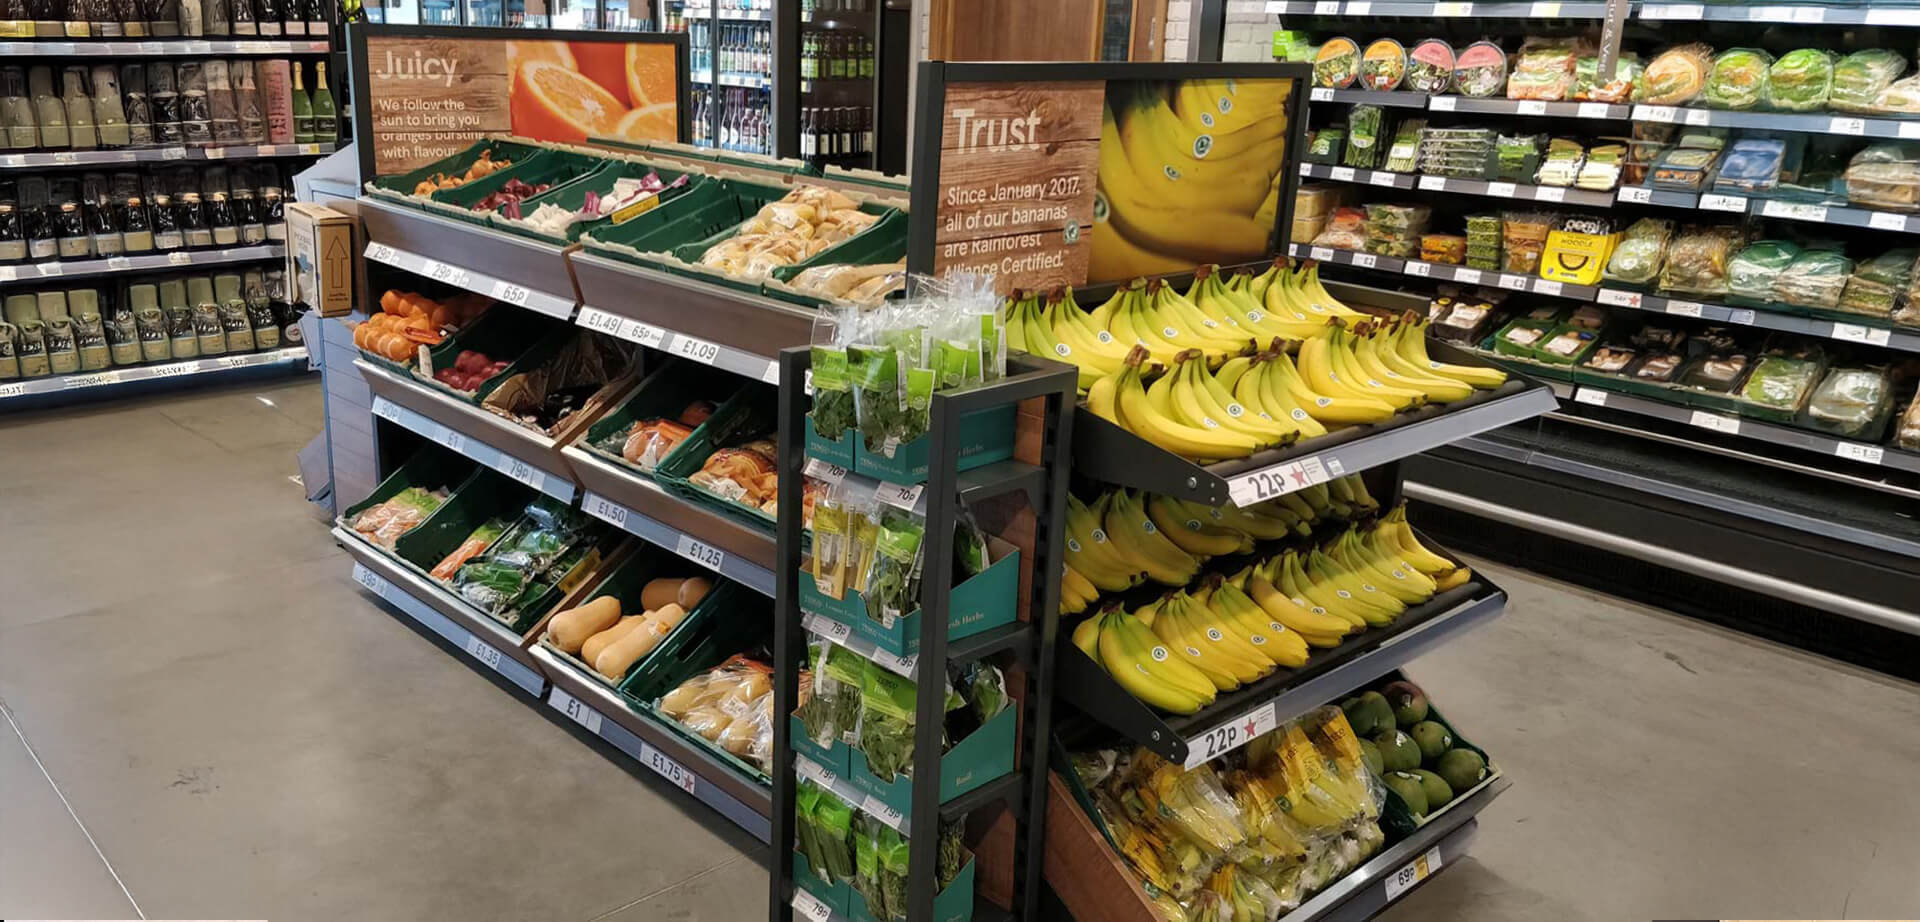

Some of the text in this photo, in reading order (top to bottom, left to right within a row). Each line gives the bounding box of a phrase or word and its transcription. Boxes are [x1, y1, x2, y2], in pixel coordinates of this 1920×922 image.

[376, 50, 458, 87] Juicy
[379, 98, 465, 111] We follow the
[380, 114, 480, 129] sun to bring you
[952, 107, 1040, 154] Trust
[382, 132, 432, 143] oranges
[382, 145, 457, 159] with flavour
[947, 186, 986, 206] Since
[990, 182, 1046, 201] January
[945, 205, 1067, 233] all of our bananas
[944, 232, 1042, 258] are Rainforest
[502, 285, 525, 304] 65p
[588, 312, 619, 331] £1.49
[631, 325, 650, 340] 65p
[682, 340, 717, 360] £1.09
[510, 460, 529, 480] 79p
[827, 464, 845, 478] 70p
[896, 488, 916, 501] 70p
[1248, 472, 1285, 499] 22p
[598, 502, 625, 523] £1.50
[689, 541, 721, 567] £1.25
[831, 622, 847, 636] 79p
[475, 642, 498, 666] £1.35
[566, 698, 581, 720] £1
[1205, 726, 1237, 758] 22p
[652, 752, 680, 781] £1.75
[1398, 867, 1415, 886] 69p
[812, 902, 828, 917] 79p
